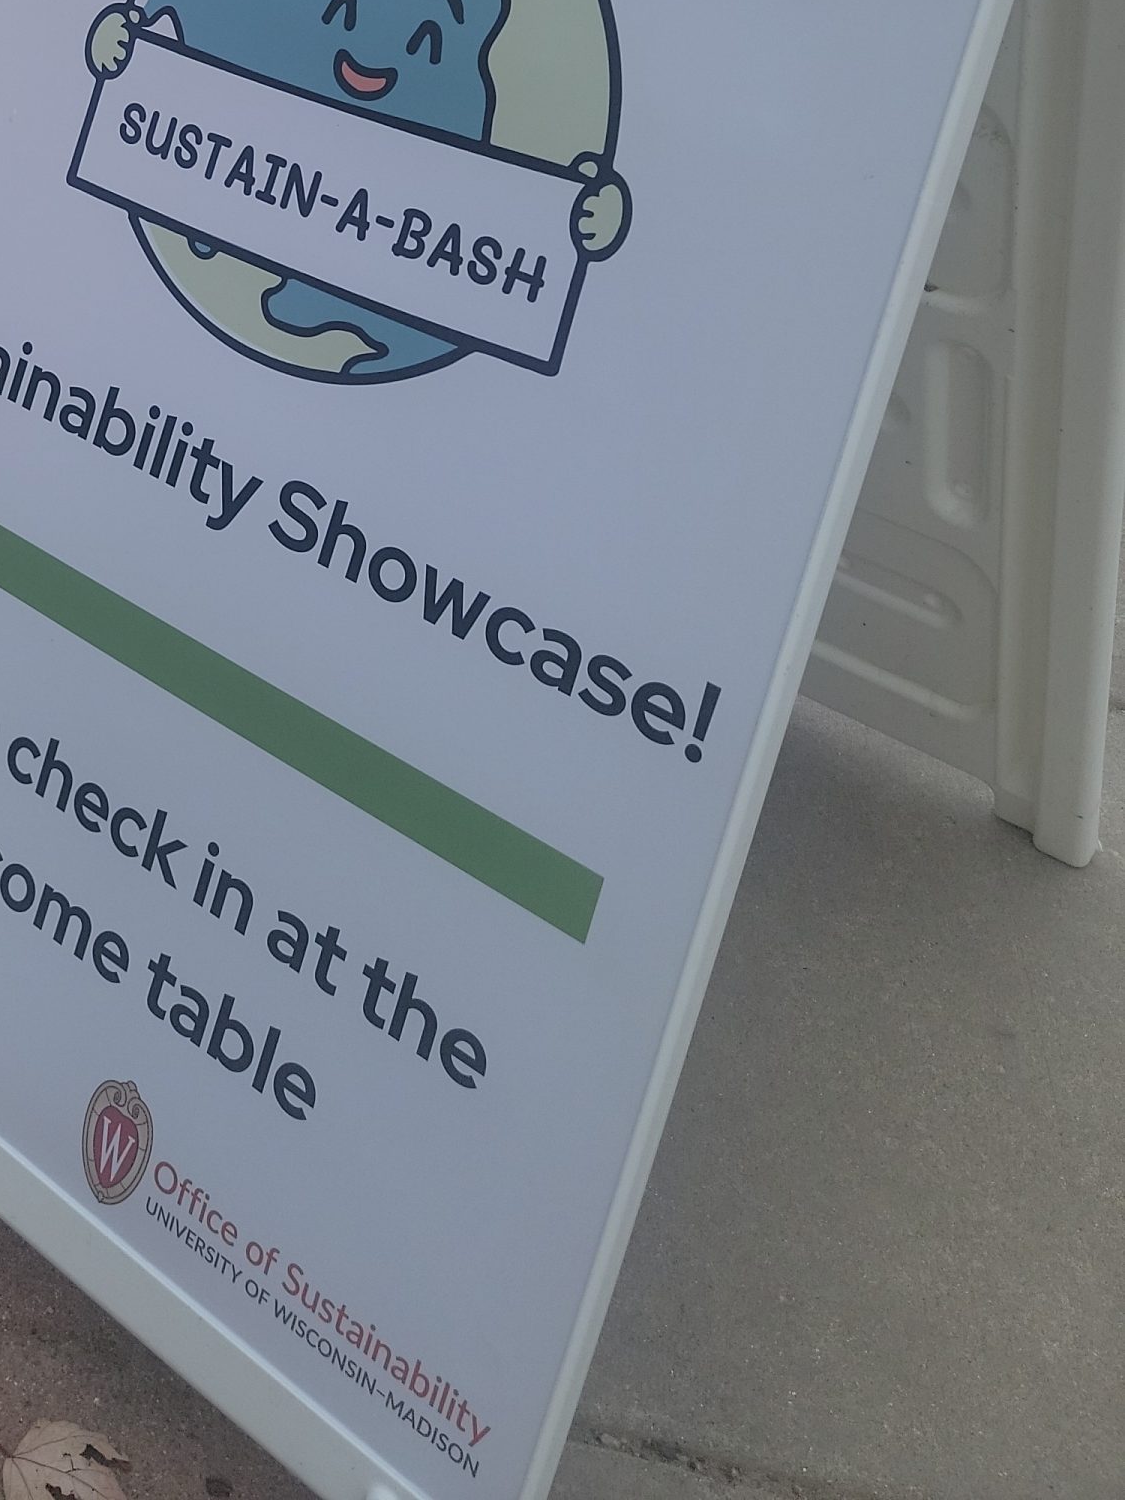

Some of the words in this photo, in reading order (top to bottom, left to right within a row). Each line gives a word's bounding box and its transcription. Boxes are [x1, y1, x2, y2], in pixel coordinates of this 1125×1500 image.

[119, 102, 547, 303] SUSTAIN-A-BASH
[269, 481, 723, 764] Showcase!
[7, 738, 188, 890] check
[192, 842, 254, 935] in
[266, 910, 347, 996] at
[361, 958, 487, 1089] the
[146, 953, 316, 1121] table
[146, 1196, 243, 1285] UNIVERSITY
[245, 1278, 271, 1306] OF
[154, 1160, 239, 1247] Office
[245, 1240, 280, 1275] of
[281, 1262, 492, 1448] Sustainability
